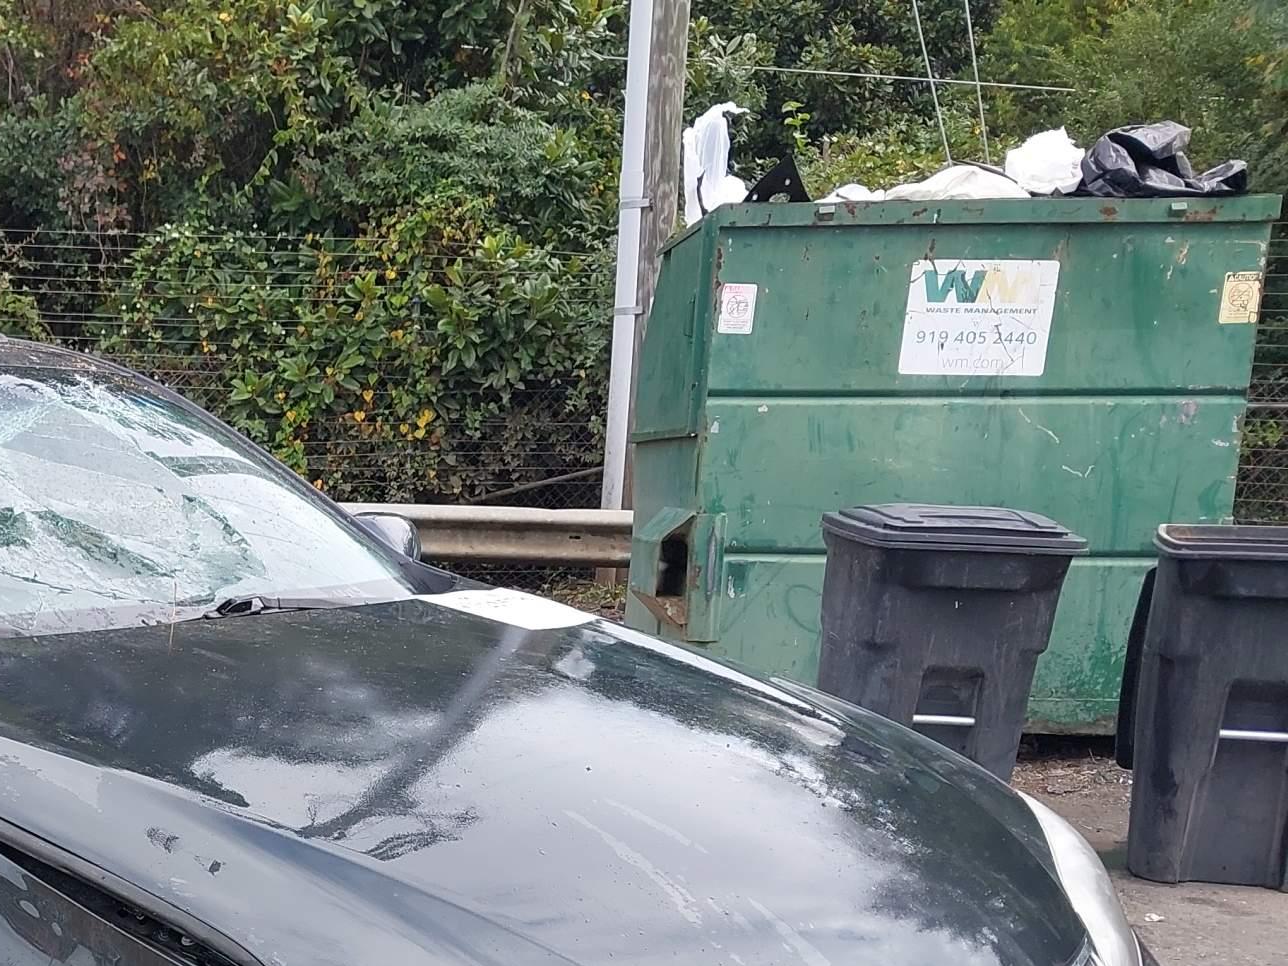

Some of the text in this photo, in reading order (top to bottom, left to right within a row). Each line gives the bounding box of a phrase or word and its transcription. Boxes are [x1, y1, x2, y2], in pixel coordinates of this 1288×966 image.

[964, 307, 1037, 315] MANAGEMENT
[916, 330, 1037, 345] 919 405 2440
[942, 353, 1003, 369] wm.com
